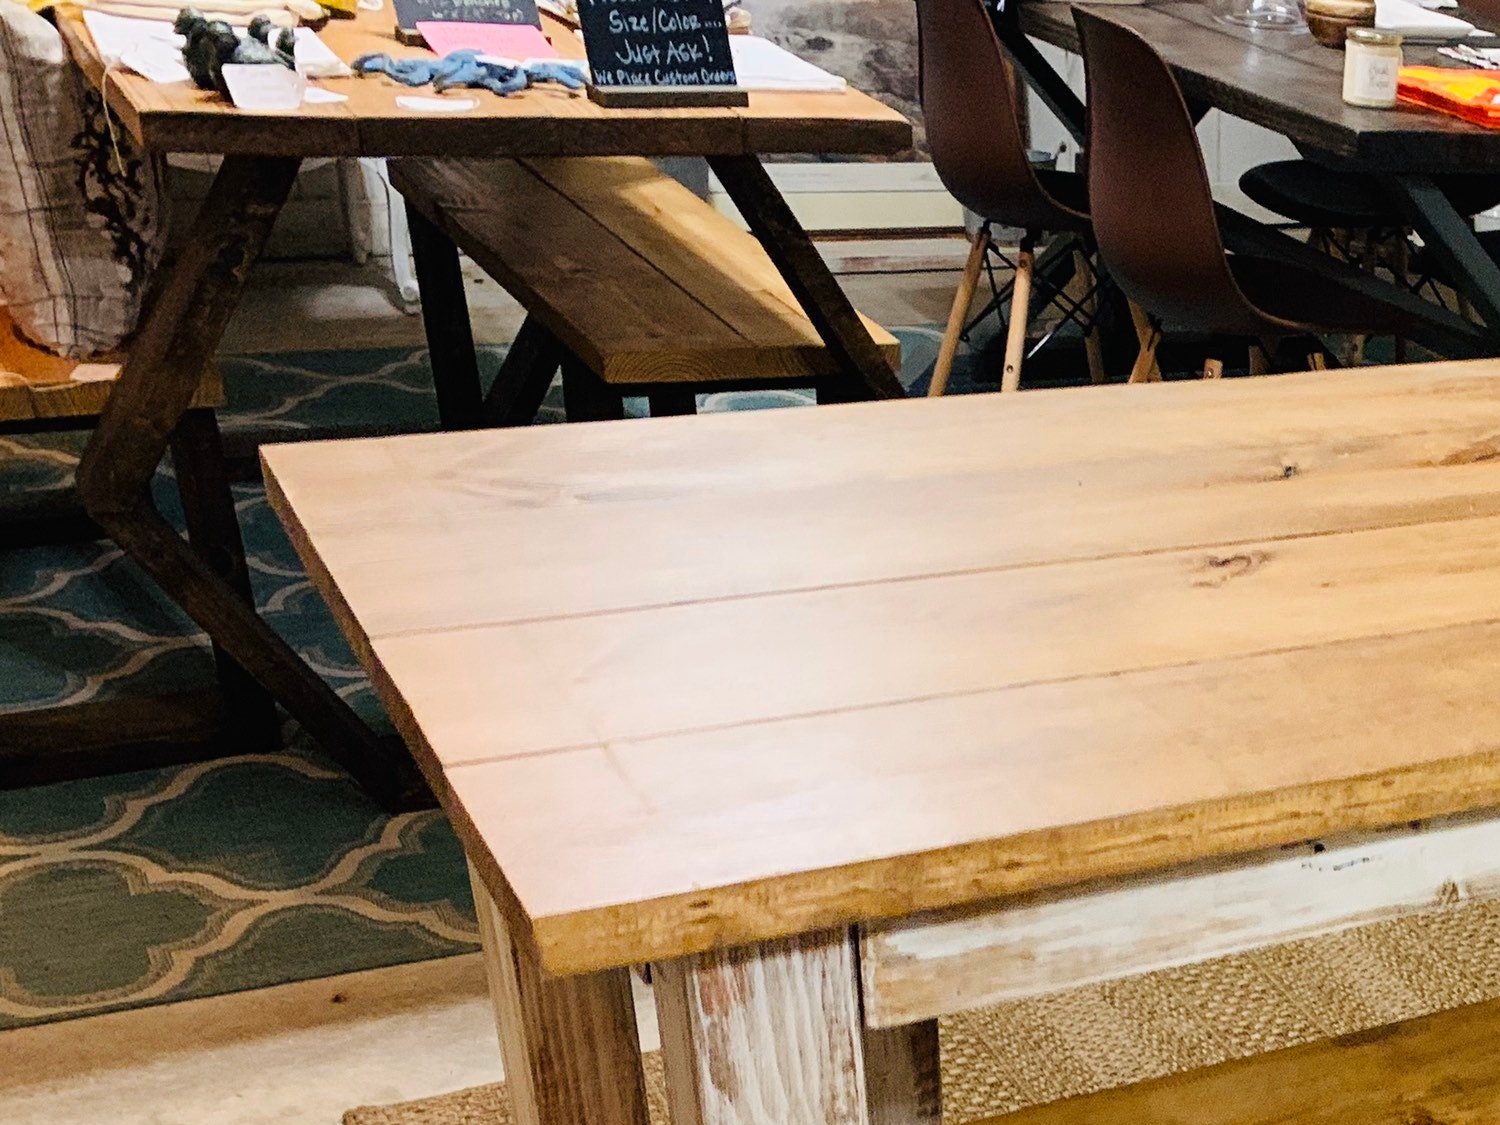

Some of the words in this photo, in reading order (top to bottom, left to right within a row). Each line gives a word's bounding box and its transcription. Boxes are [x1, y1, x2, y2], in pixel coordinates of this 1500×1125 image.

[594, 69, 614, 85] We
[616, 69, 651, 86] Place
[654, 69, 700, 86] Custom
